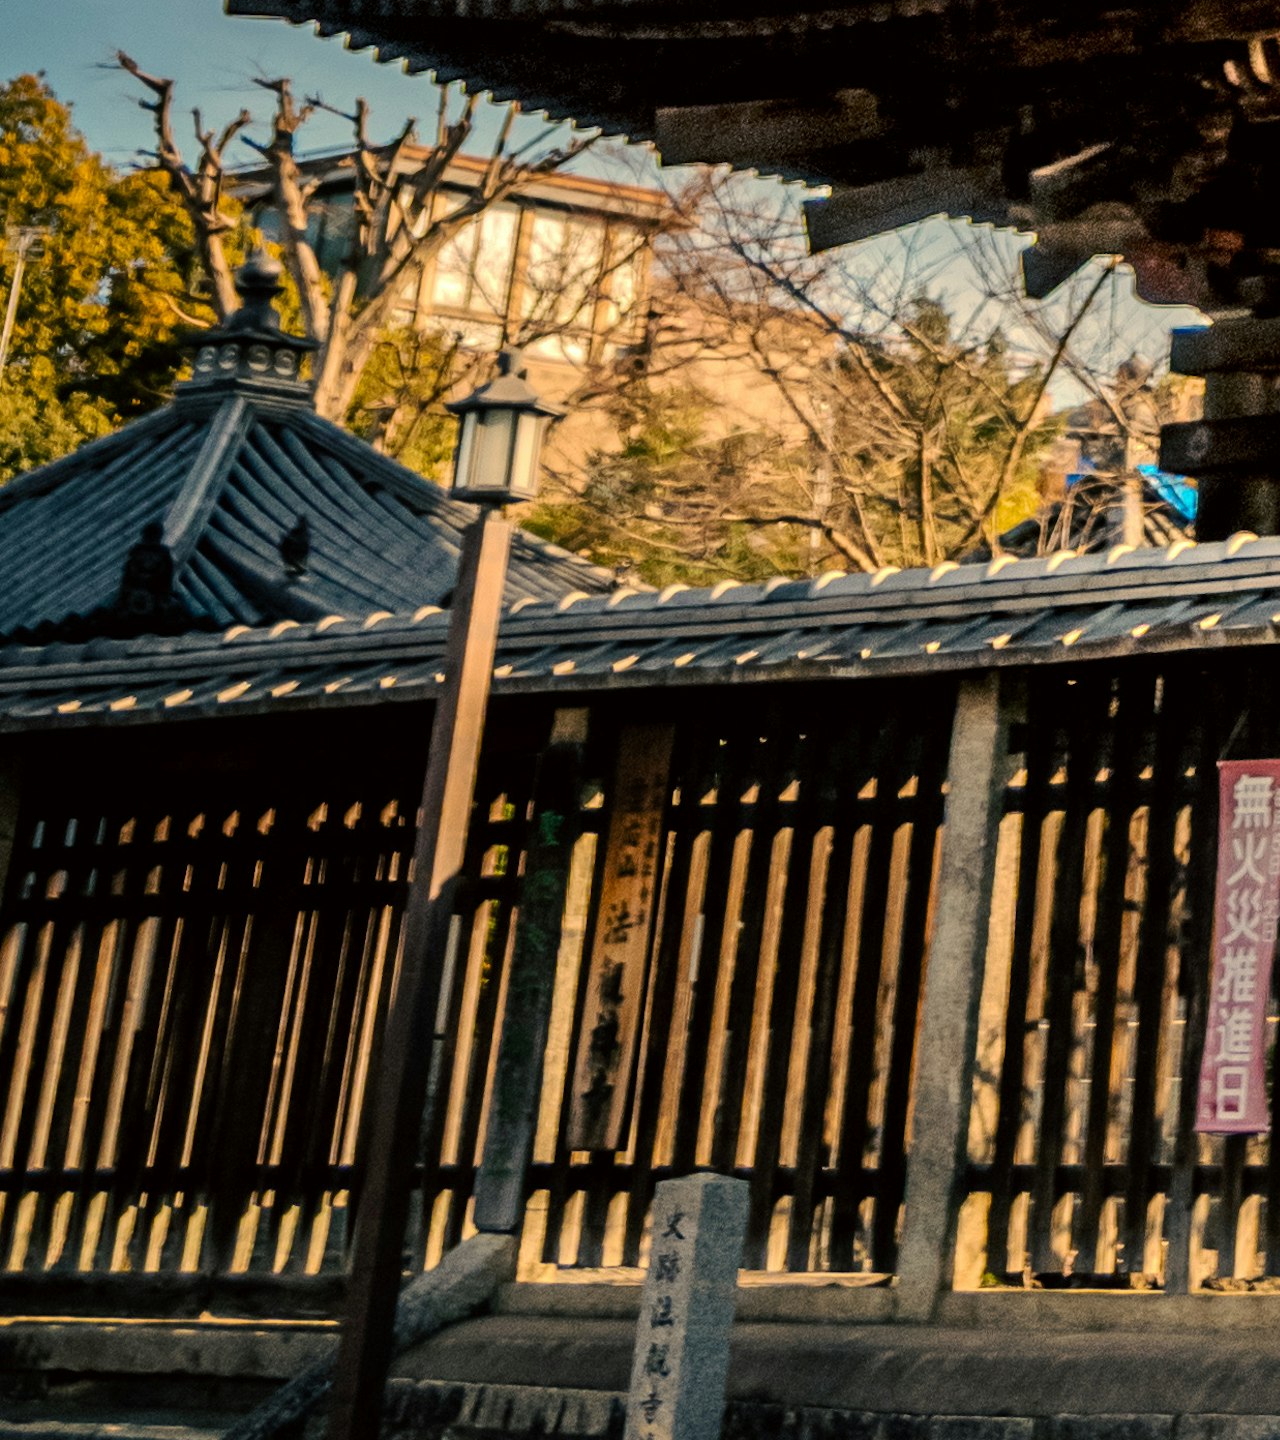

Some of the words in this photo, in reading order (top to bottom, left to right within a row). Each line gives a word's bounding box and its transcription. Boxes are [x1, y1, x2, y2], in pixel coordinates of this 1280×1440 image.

[1216, 774, 1274, 1121] 無火災推進日
